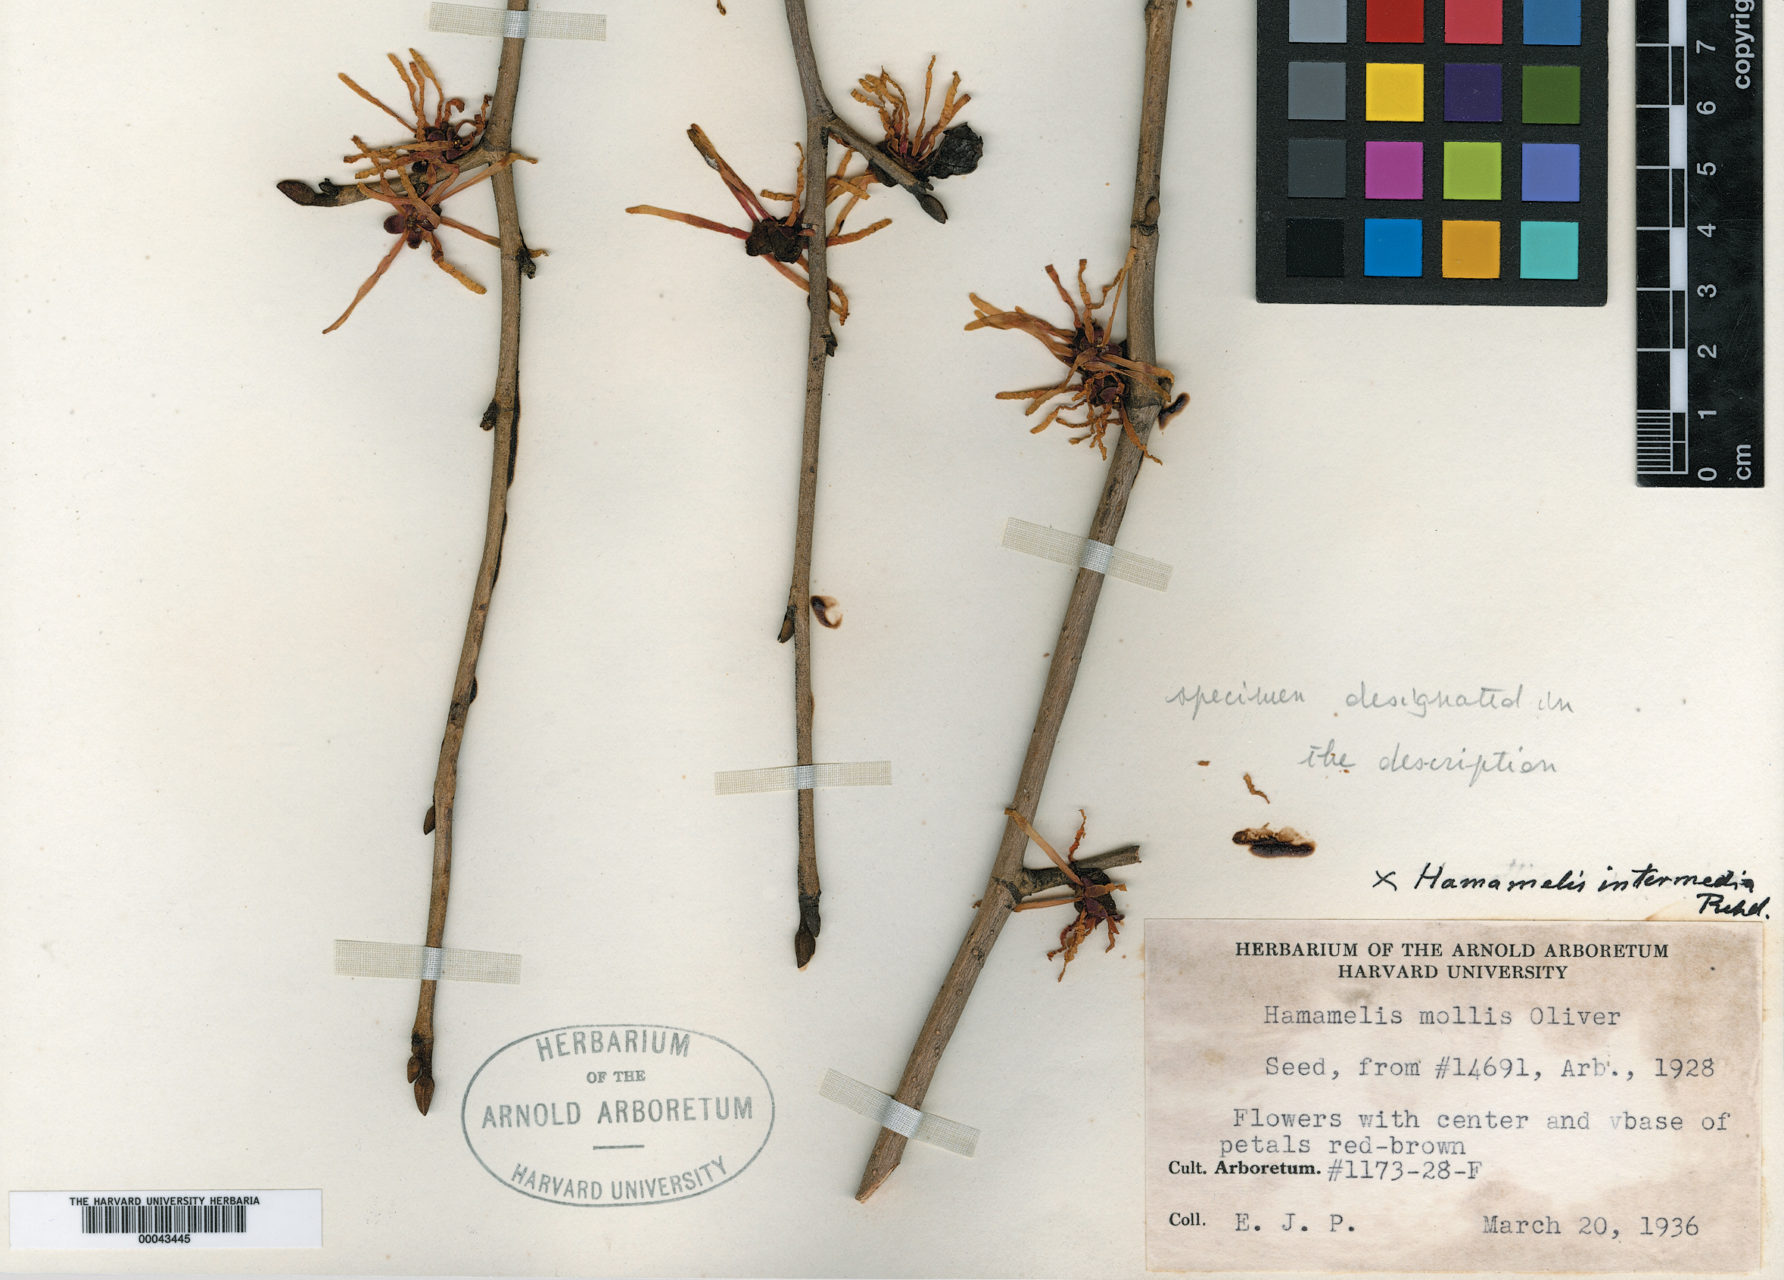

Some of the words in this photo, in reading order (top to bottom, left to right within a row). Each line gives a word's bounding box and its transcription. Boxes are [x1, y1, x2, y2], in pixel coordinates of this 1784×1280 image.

[1696, 40, 1717, 54] 7
[1696, 100, 1717, 115] 6
[1696, 163, 1717, 177] 5
[1696, 223, 1717, 238] 4
[1696, 284, 1717, 299] 3
[1696, 345, 1717, 359] 2
[1696, 409, 1717, 419] 1
[1736, 444, 1751, 481] cm
[1696, 467, 1717, 482] 0
[1345, 682, 1522, 716] designated
[1300, 740, 1356, 768] the
[1379, 743, 1559, 787] description
[1415, 864, 1587, 890] Hamamelis
[1598, 864, 1755, 892] intermedia
[1235, 943, 1359, 958] HERBARIUM
[1367, 943, 1394, 958] OF
[1401, 943, 1443, 958] THE
[1451, 943, 1536, 958] ARNOLD
[1544, 943, 1669, 959] ARBORETUM
[1338, 964, 1438, 979] HARVARD
[1447, 964, 1568, 979] UNIVERSITY
[1264, 1006, 1403, 1025] Hamamelis
[1420, 1006, 1512, 1026] mollis
[1530, 1007, 1621, 1026] Oliver
[536, 1029, 691, 1062] HERBARIUM
[587, 1071, 607, 1083] OF
[613, 1070, 646, 1082] THE
[1265, 1058, 1340, 1081] Seed,
[1358, 1058, 1421, 1076] from
[1435, 1058, 1542, 1081] #14691,
[1655, 1058, 1714, 1078] 1928
[482, 1102, 581, 1128] ARNOLD
[597, 1096, 753, 1124] ARBORETUM
[1233, 1109, 1342, 1129] Flowers
[1358, 1110, 1420, 1129] with
[1437, 1111, 1529, 1130] center
[1546, 1111, 1590, 1130] and
[1700, 1111, 1731, 1131] of
[1219, 1135, 1311, 1157] petals
[1328, 1135, 1466, 1155] red-brown
[511, 1163, 601, 1200] HARVARD
[611, 1155, 728, 1200] UNIVERSITY
[1169, 1161, 1207, 1176] Cult.
[1214, 1161, 1321, 1176] Arboretum.
[1327, 1160, 1483, 1181] #1173-28-F
[70, 1197, 89, 1206] THE
[94, 1197, 141, 1206] HARVARD
[147, 1197, 205, 1205] UNIVERSITY
[210, 1197, 259, 1205] HERBARIA
[1169, 1213, 1206, 1227] Coll.
[1236, 1213, 1262, 1232] E.
[1282, 1213, 1309, 1232] J.
[1330, 1213, 1356, 1232] P.
[1483, 1215, 1561, 1235] March
[1579, 1216, 1621, 1239] 20,
[1640, 1216, 1699, 1236] 1936
[139, 1234, 190, 1243] 00043445
